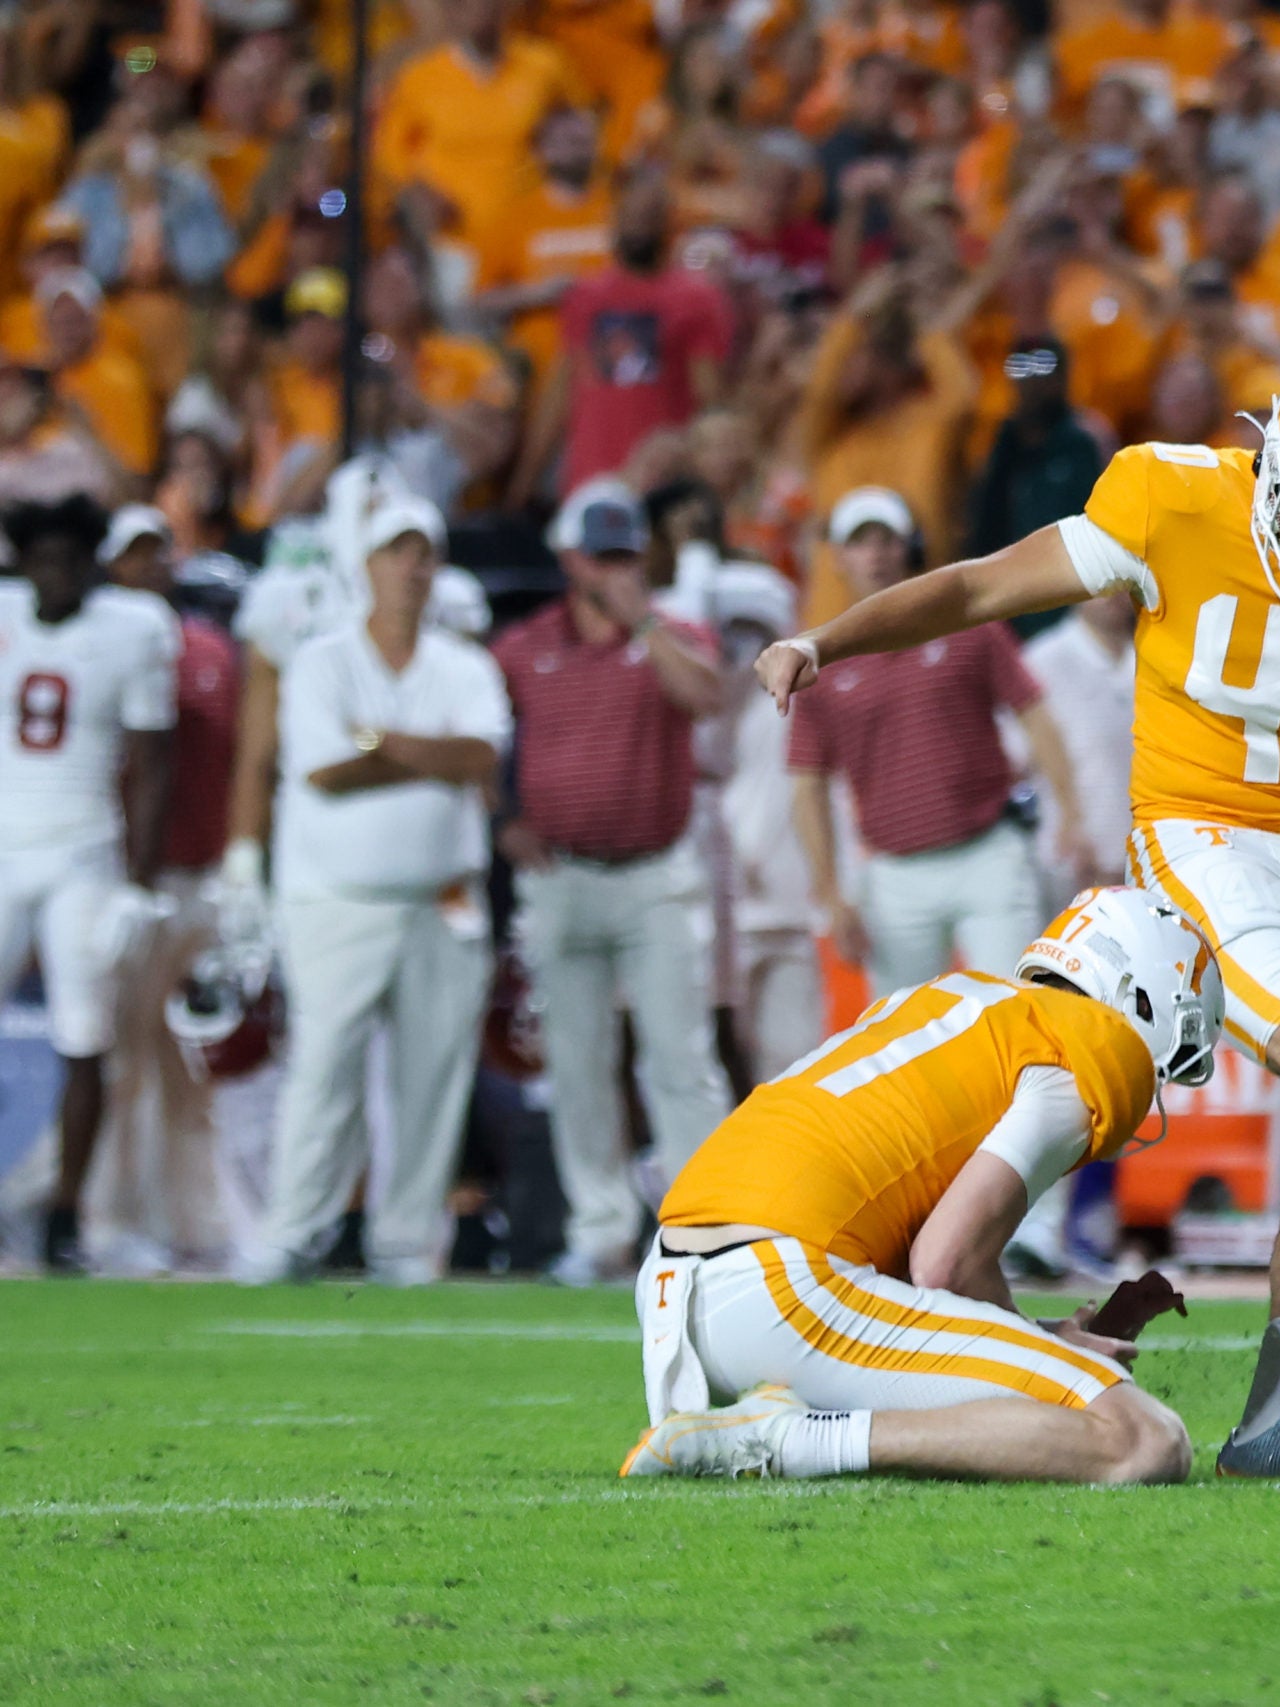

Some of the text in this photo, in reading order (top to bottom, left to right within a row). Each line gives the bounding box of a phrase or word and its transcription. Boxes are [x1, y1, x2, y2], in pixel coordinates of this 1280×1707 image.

[20, 672, 68, 750] 8
[1065, 914, 1093, 944] 7
[656, 1270, 675, 1309] T
